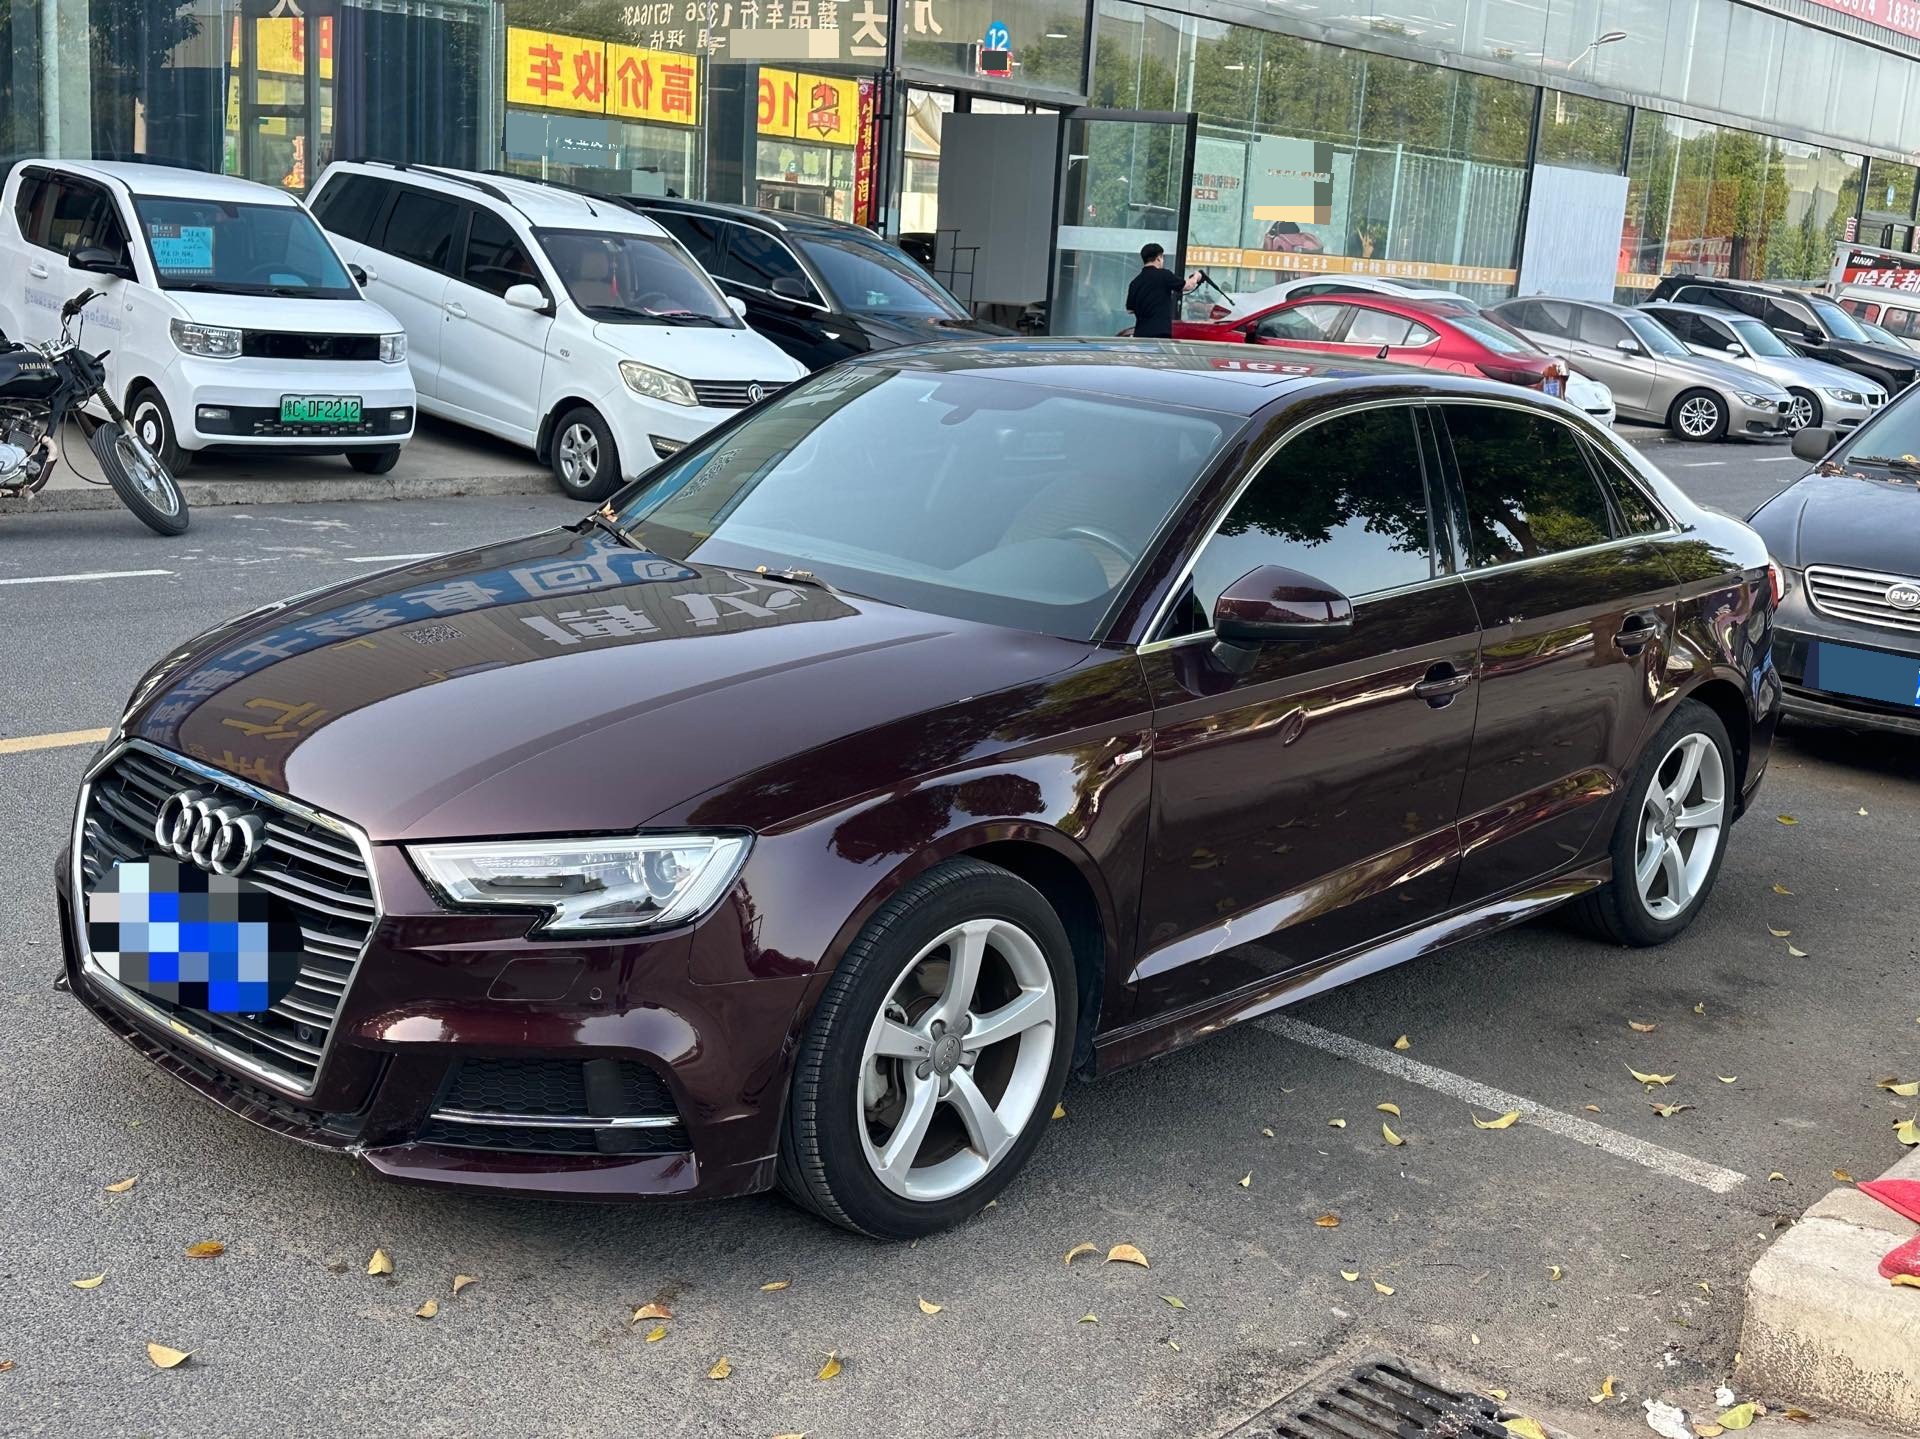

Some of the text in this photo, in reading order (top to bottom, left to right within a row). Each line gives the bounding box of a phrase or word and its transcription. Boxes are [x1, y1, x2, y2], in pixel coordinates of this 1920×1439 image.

[989, 28, 1008, 51] 12
[308, 400, 359, 418] DF2212
[1890, 590, 1919, 603] BYD
